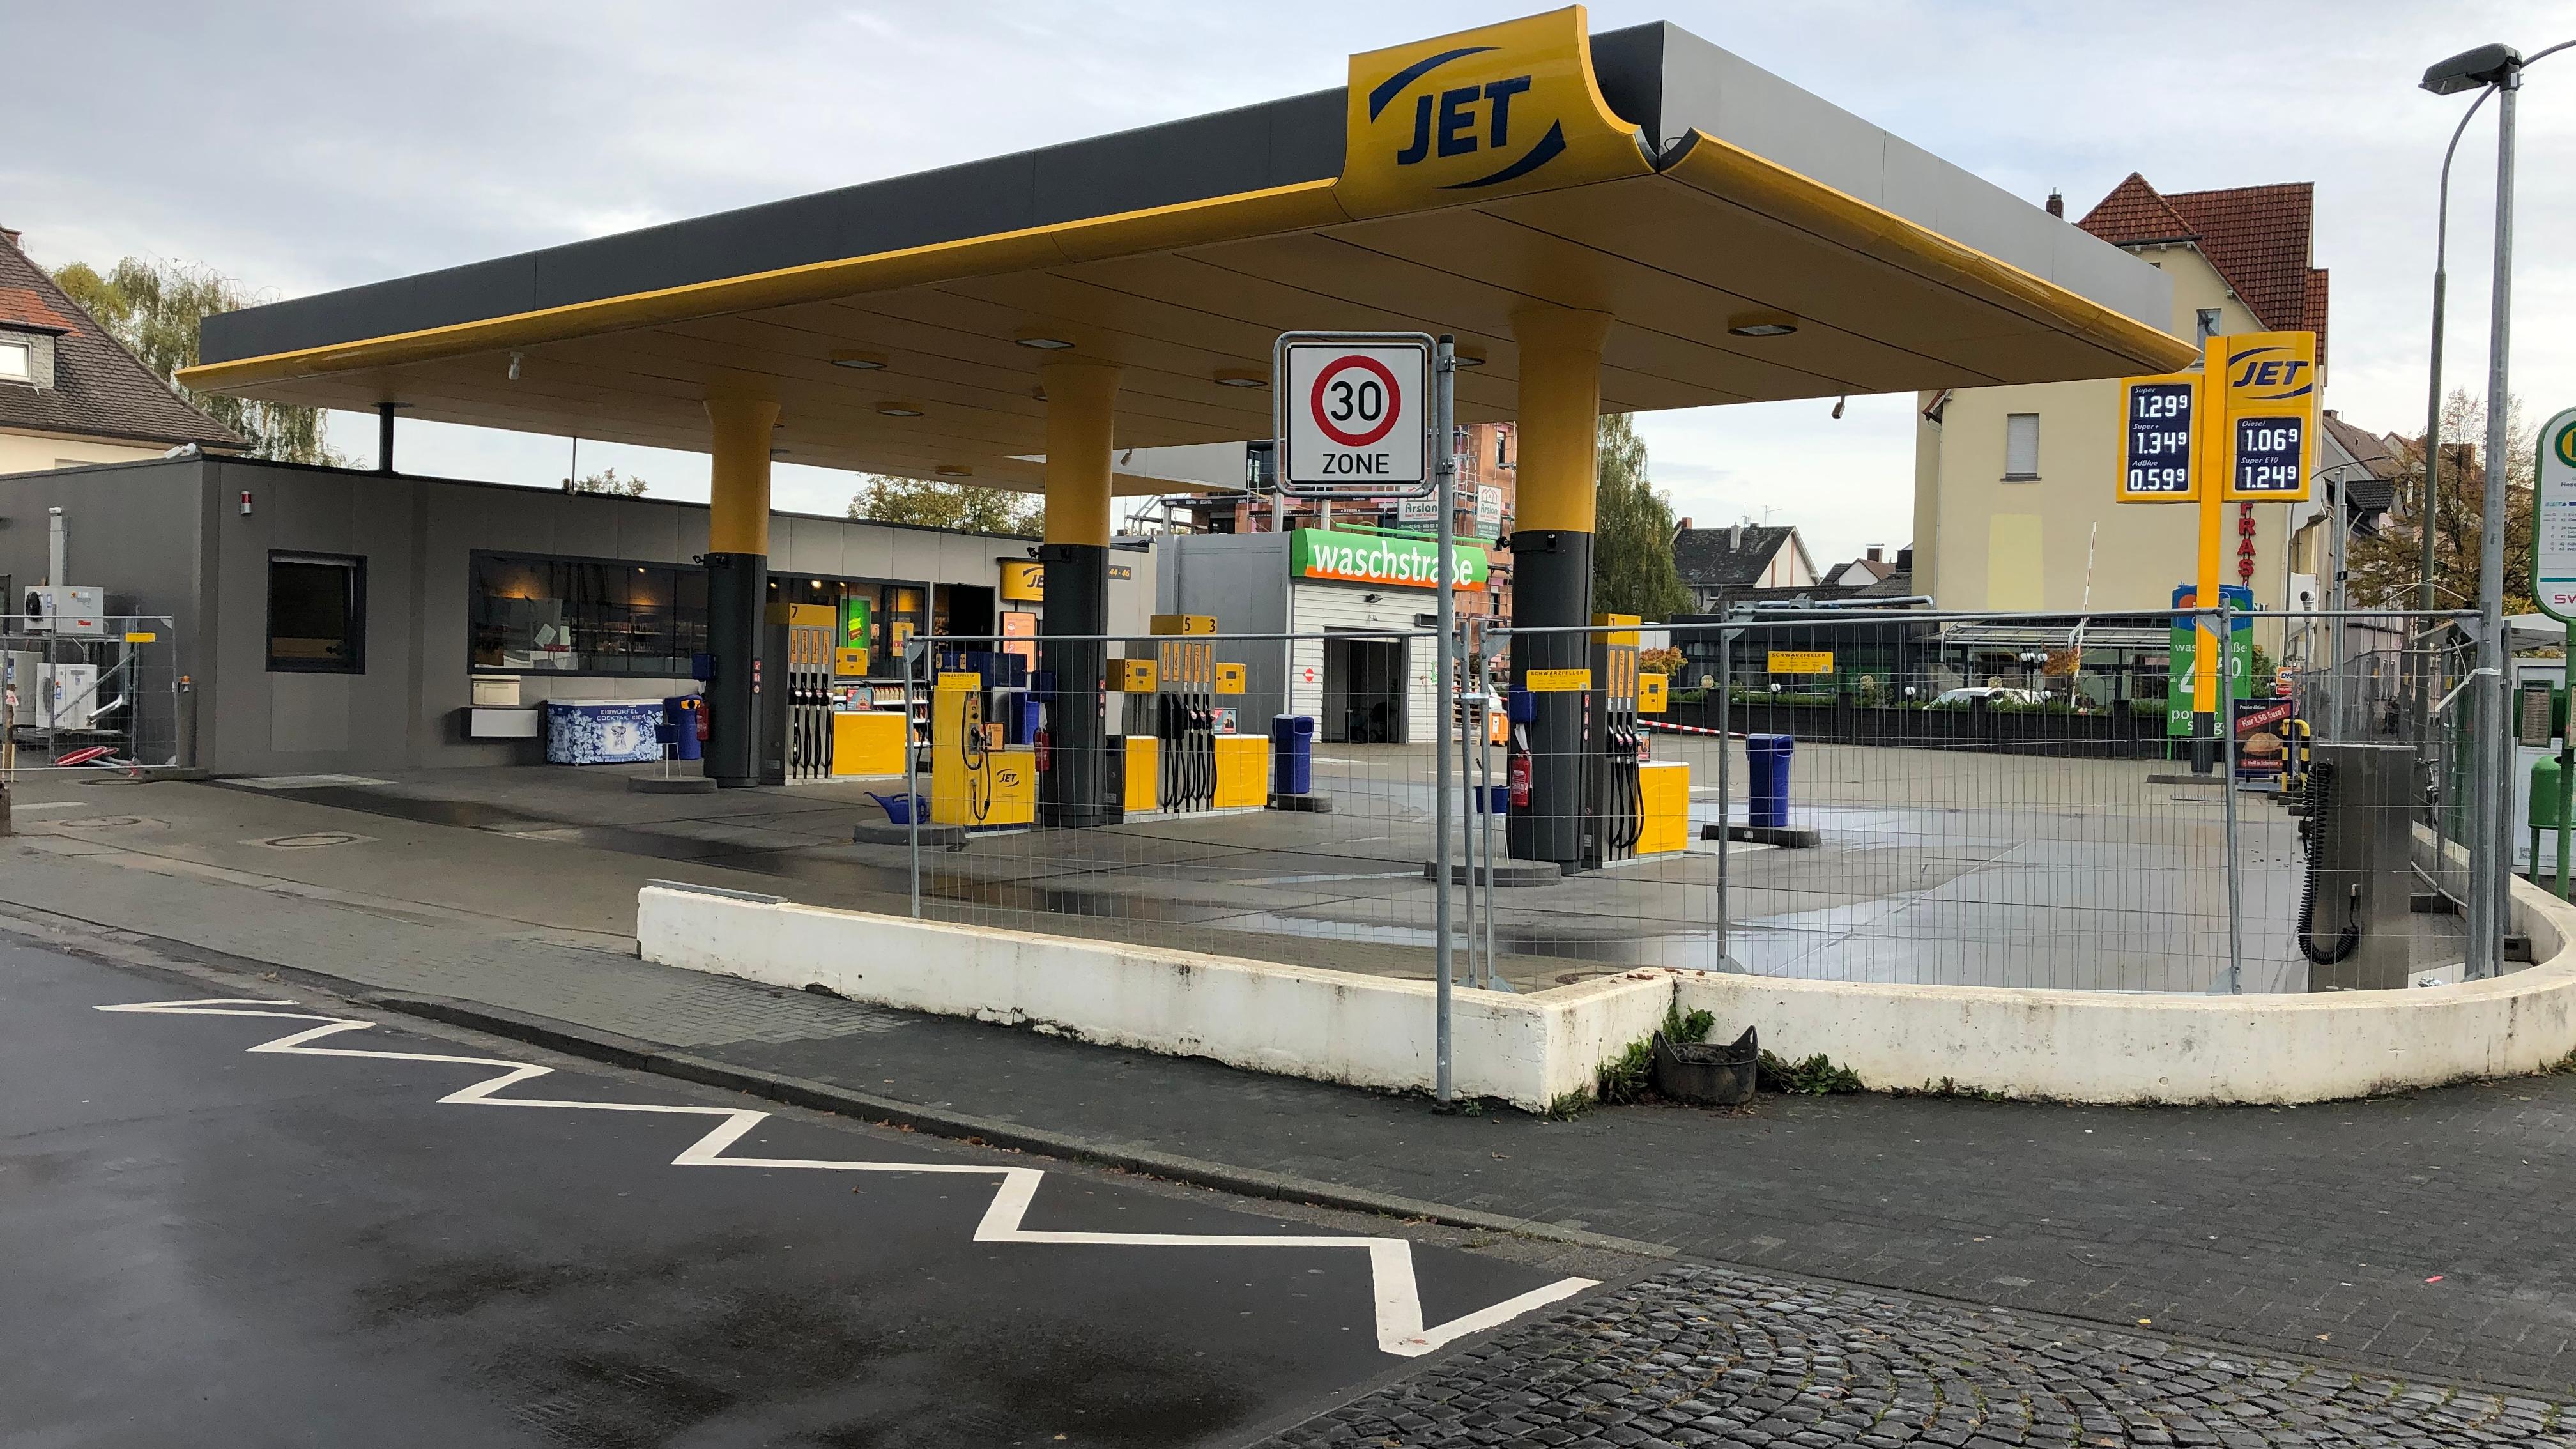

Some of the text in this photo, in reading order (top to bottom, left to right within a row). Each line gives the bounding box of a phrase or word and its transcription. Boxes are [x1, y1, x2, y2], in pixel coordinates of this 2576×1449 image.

[1397, 75, 1532, 165] JET
[2232, 361, 2308, 387] JET
[1330, 381, 1381, 422] 30
[1322, 453, 1390, 474] ZONE
[2241, 457, 2263, 465] Super
[1405, 503, 1438, 513] Arslan
[1481, 503, 1498, 515] Arslan
[792, 606, 797, 618] 7
[1184, 617, 1191, 631] 5
[1209, 618, 1215, 632] 3
[2241, 718, 2254, 728] Nur
[999, 773, 1017, 783] JET
